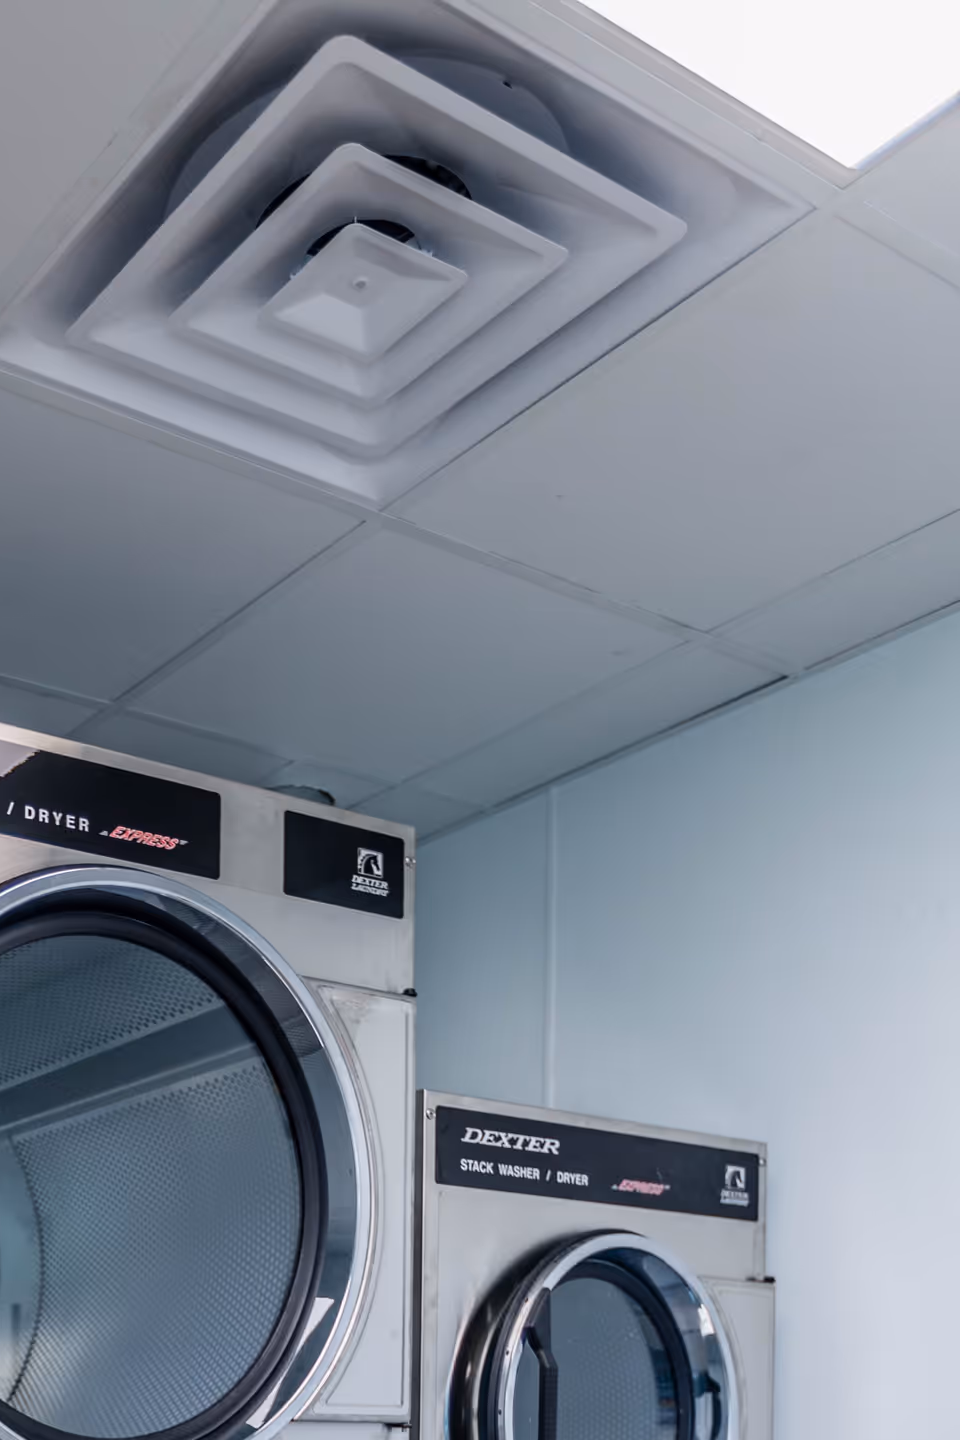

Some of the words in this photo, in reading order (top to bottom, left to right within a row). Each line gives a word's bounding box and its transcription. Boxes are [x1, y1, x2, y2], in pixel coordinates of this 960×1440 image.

[6, 801, 15, 816] /
[24, 805, 90, 832] DRYER
[109, 825, 180, 850] EXPRESS
[352, 874, 389, 890] DEXTER
[461, 1127, 560, 1155] DEXTER
[460, 1158, 494, 1174] STACK
[498, 1163, 540, 1180] WASHER
[557, 1171, 589, 1186] DRYER
